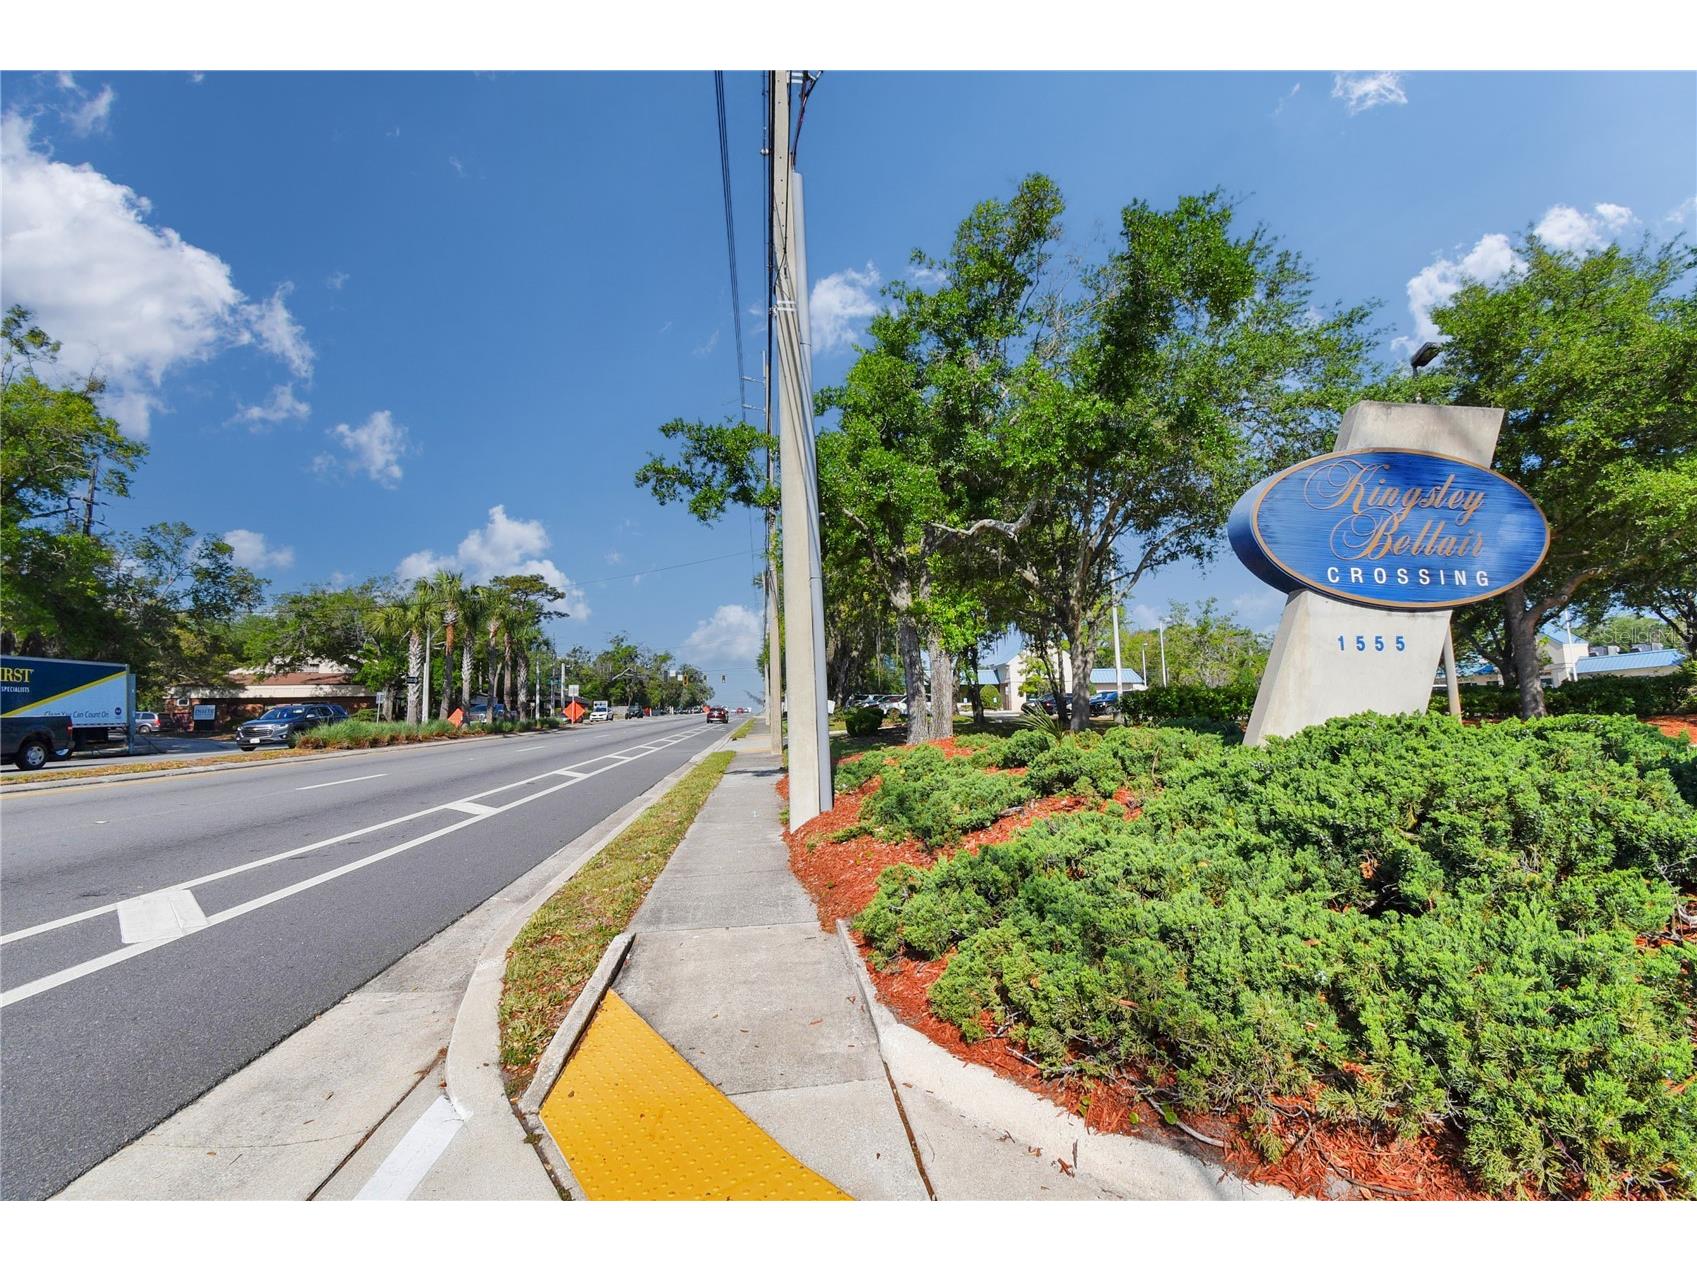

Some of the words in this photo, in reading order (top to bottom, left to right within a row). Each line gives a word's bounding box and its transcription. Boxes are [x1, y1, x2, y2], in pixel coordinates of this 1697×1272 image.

[1304, 459, 1486, 526] Kingsley
[1330, 507, 1483, 560] Bellair
[1327, 567, 1489, 586] CROSSING
[1337, 635, 1405, 651] 1555
